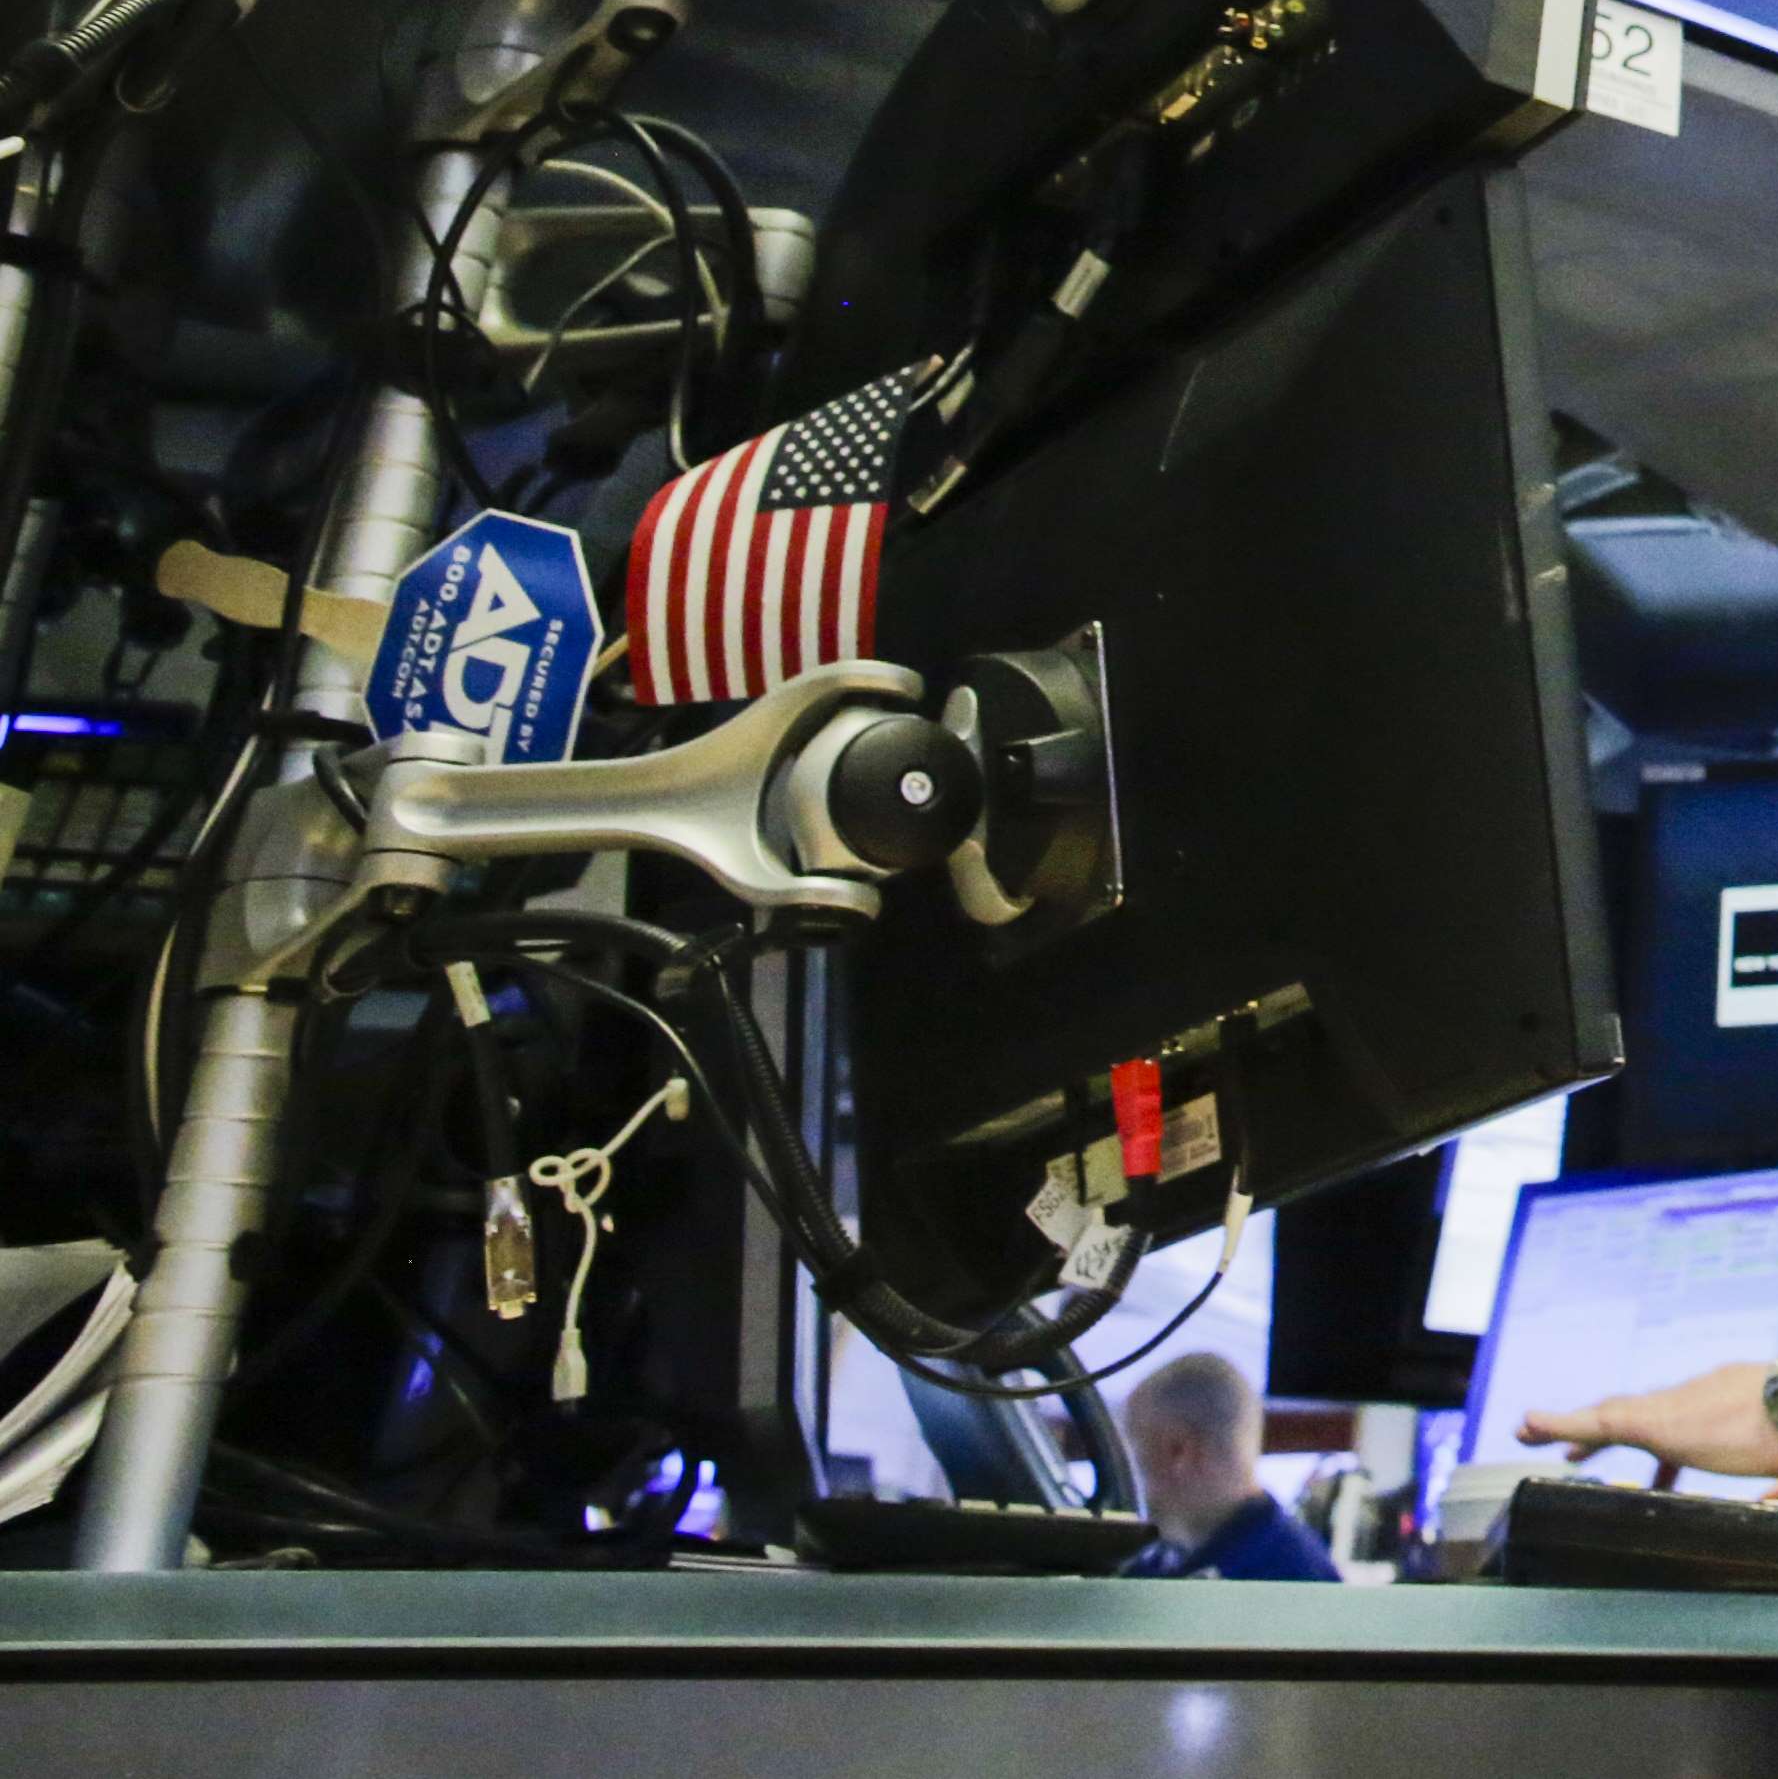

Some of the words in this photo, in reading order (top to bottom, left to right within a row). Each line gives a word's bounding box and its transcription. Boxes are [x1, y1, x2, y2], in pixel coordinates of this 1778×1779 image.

[391, 597, 430, 700] ADT.COM
[430, 541, 543, 764] ADT
[518, 618, 564, 722] SECURED
[515, 721, 534, 755] BY
